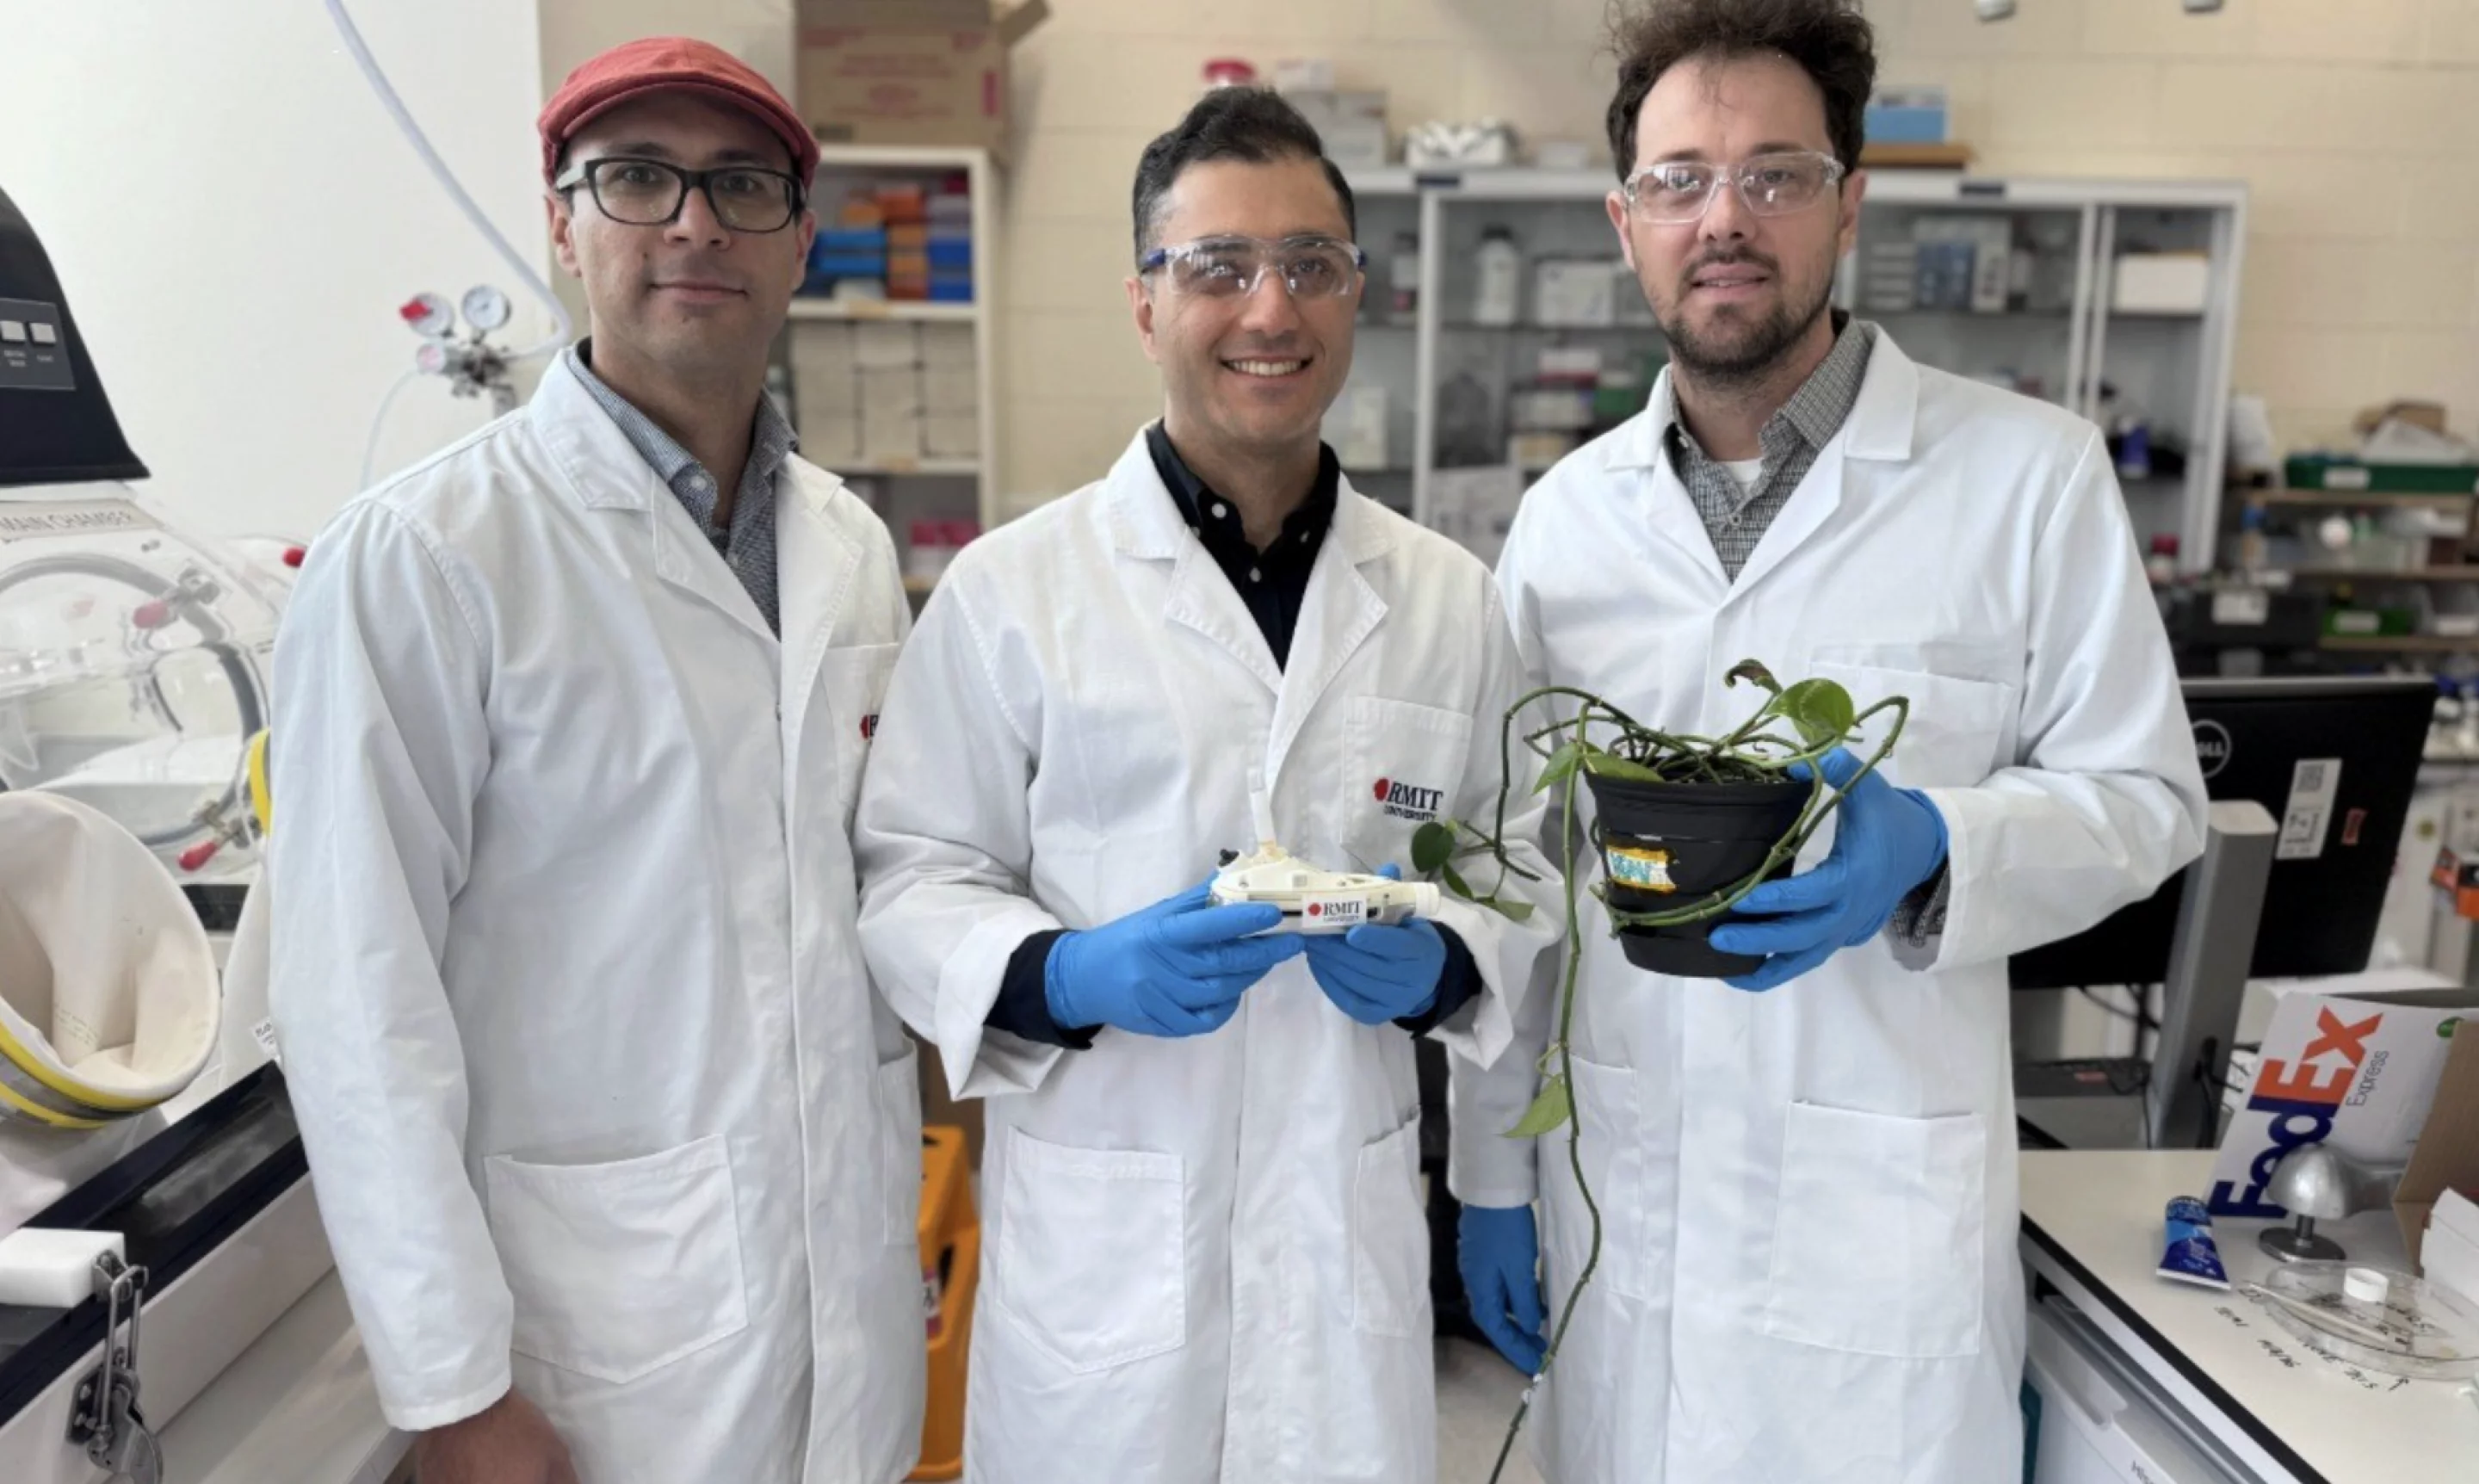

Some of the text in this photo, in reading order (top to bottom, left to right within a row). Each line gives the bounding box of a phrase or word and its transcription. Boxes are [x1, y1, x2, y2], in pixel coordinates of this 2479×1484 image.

[2196, 741, 2225, 757] ELL
[1387, 781, 1444, 812] RMIT
[1323, 900, 1363, 917] RMIT
[2346, 1049, 2389, 1108] Express
[2207, 1005, 2383, 1219] FedEx
